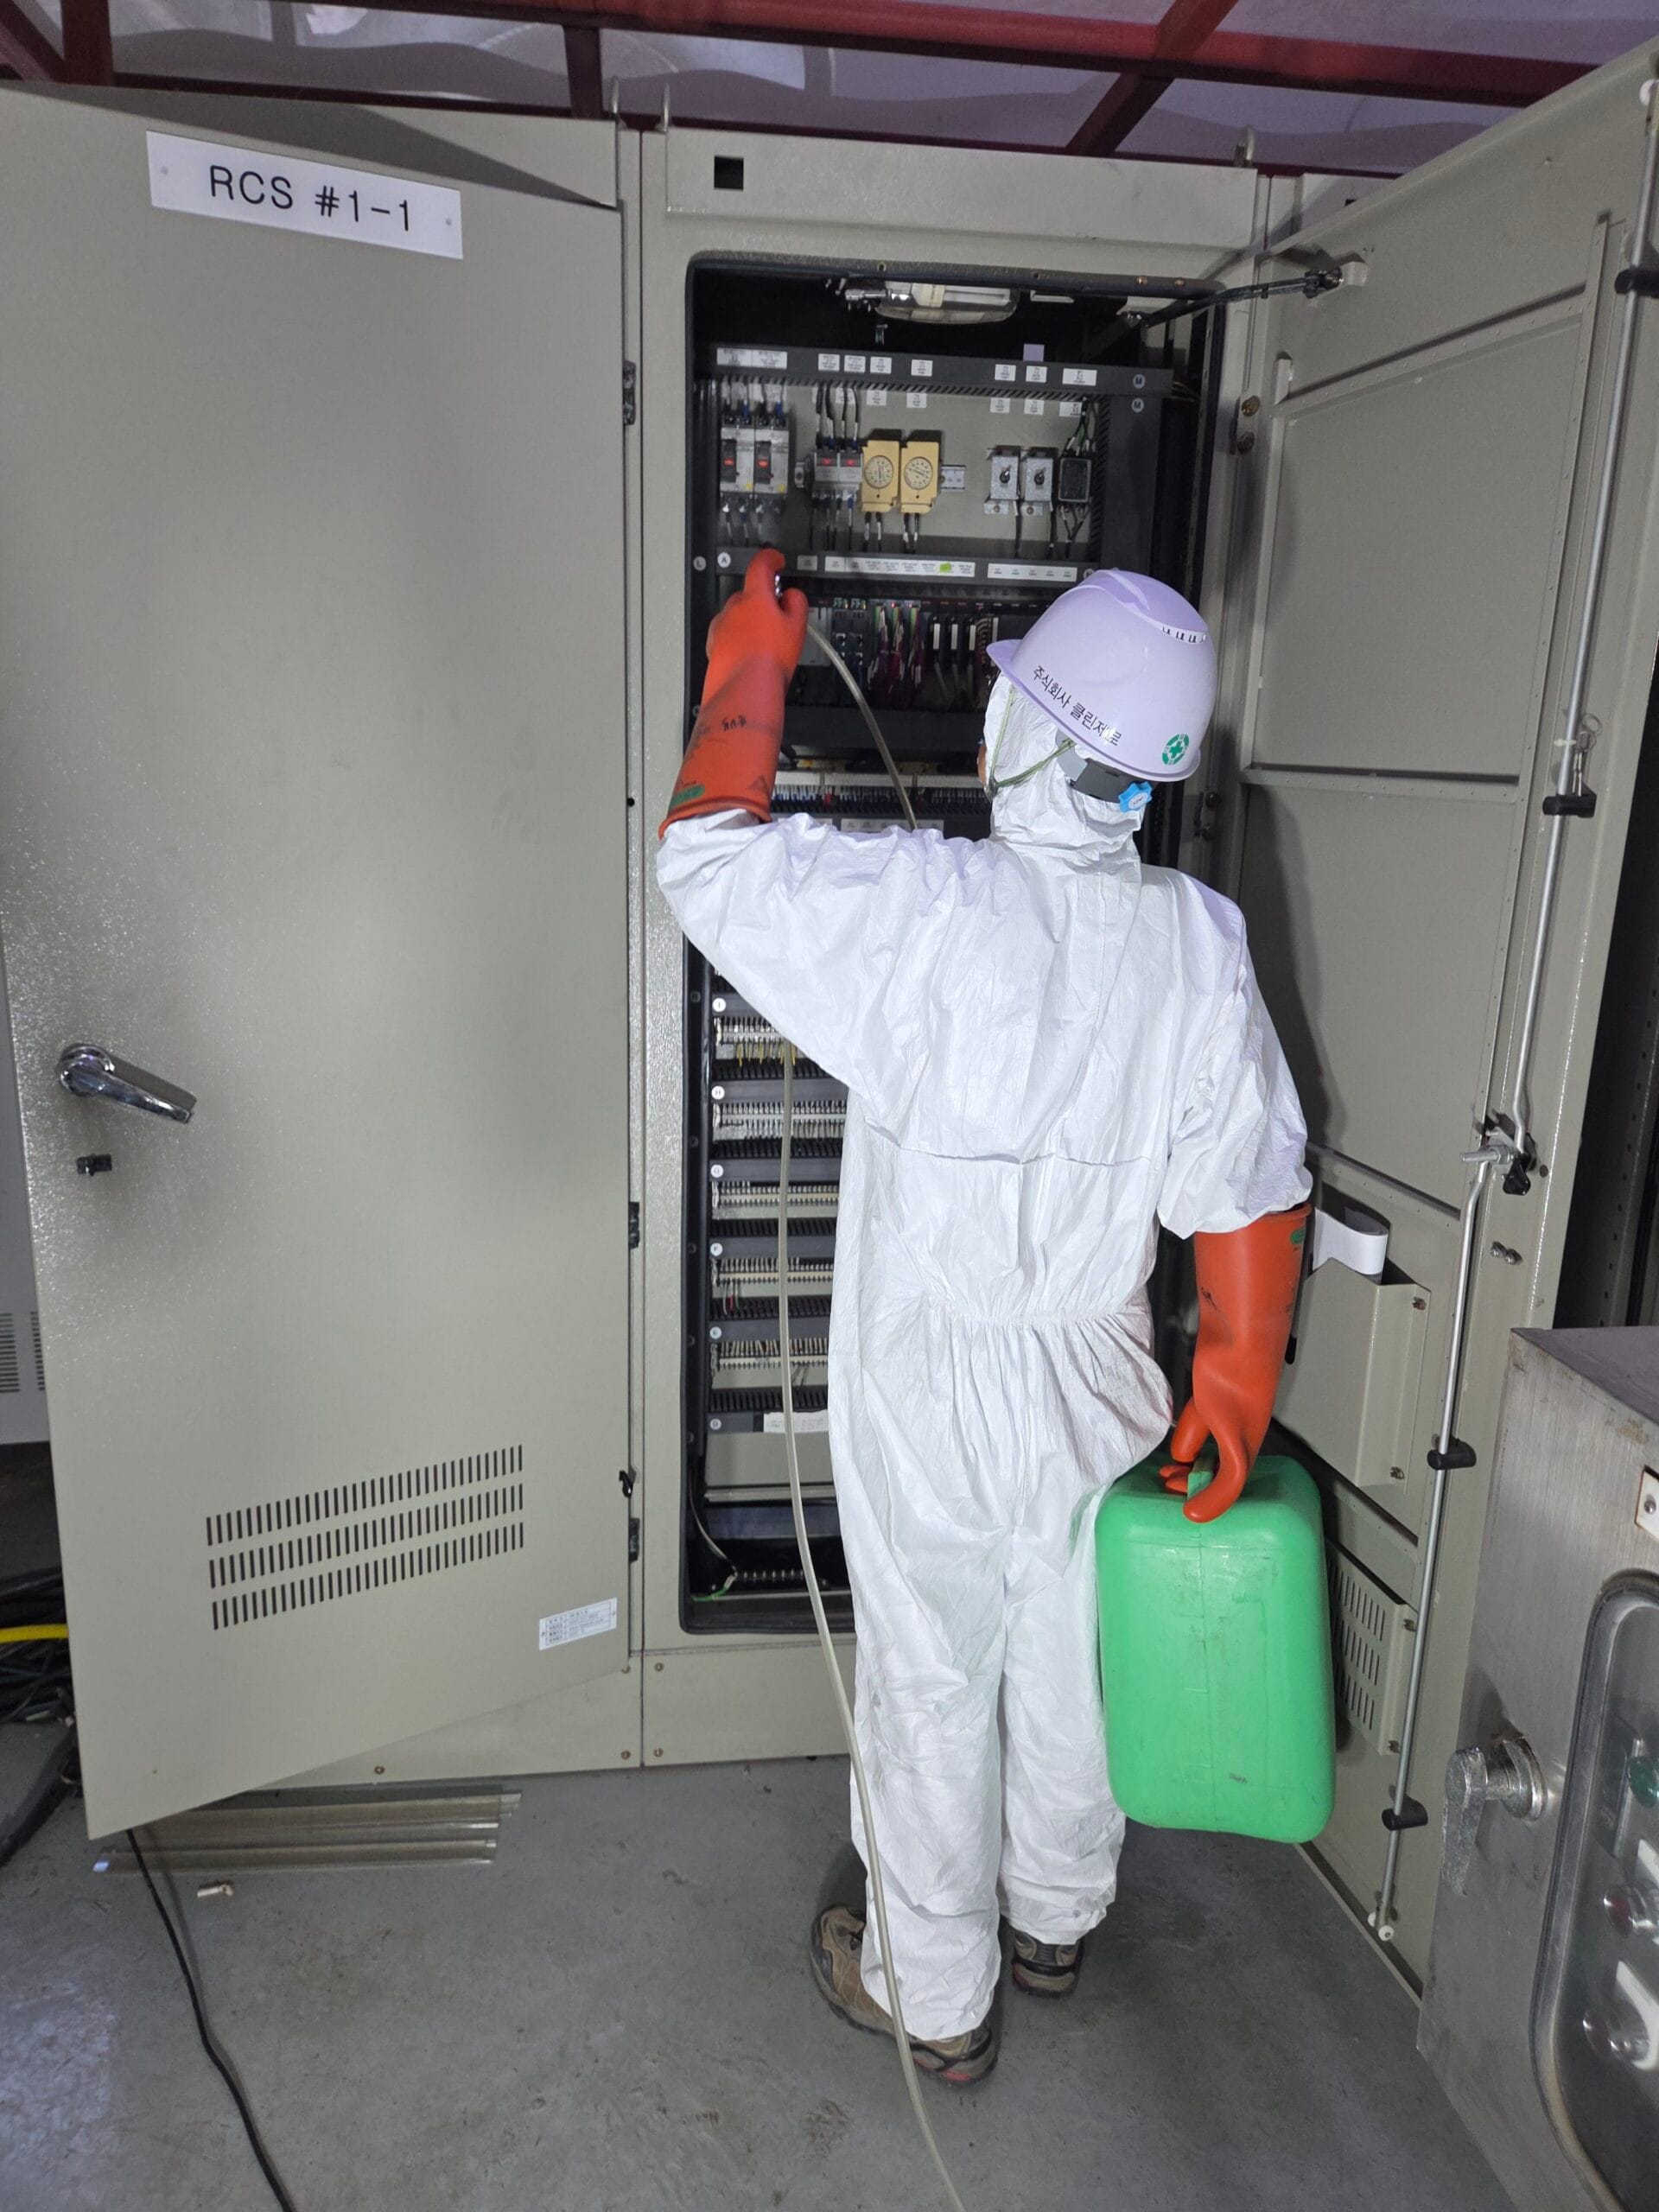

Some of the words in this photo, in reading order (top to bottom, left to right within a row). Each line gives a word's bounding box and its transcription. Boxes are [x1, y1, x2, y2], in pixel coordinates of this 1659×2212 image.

[209, 164, 294, 210] RCS
[315, 184, 410, 232] #1-1
[1033, 664, 1072, 709] 주식회사
